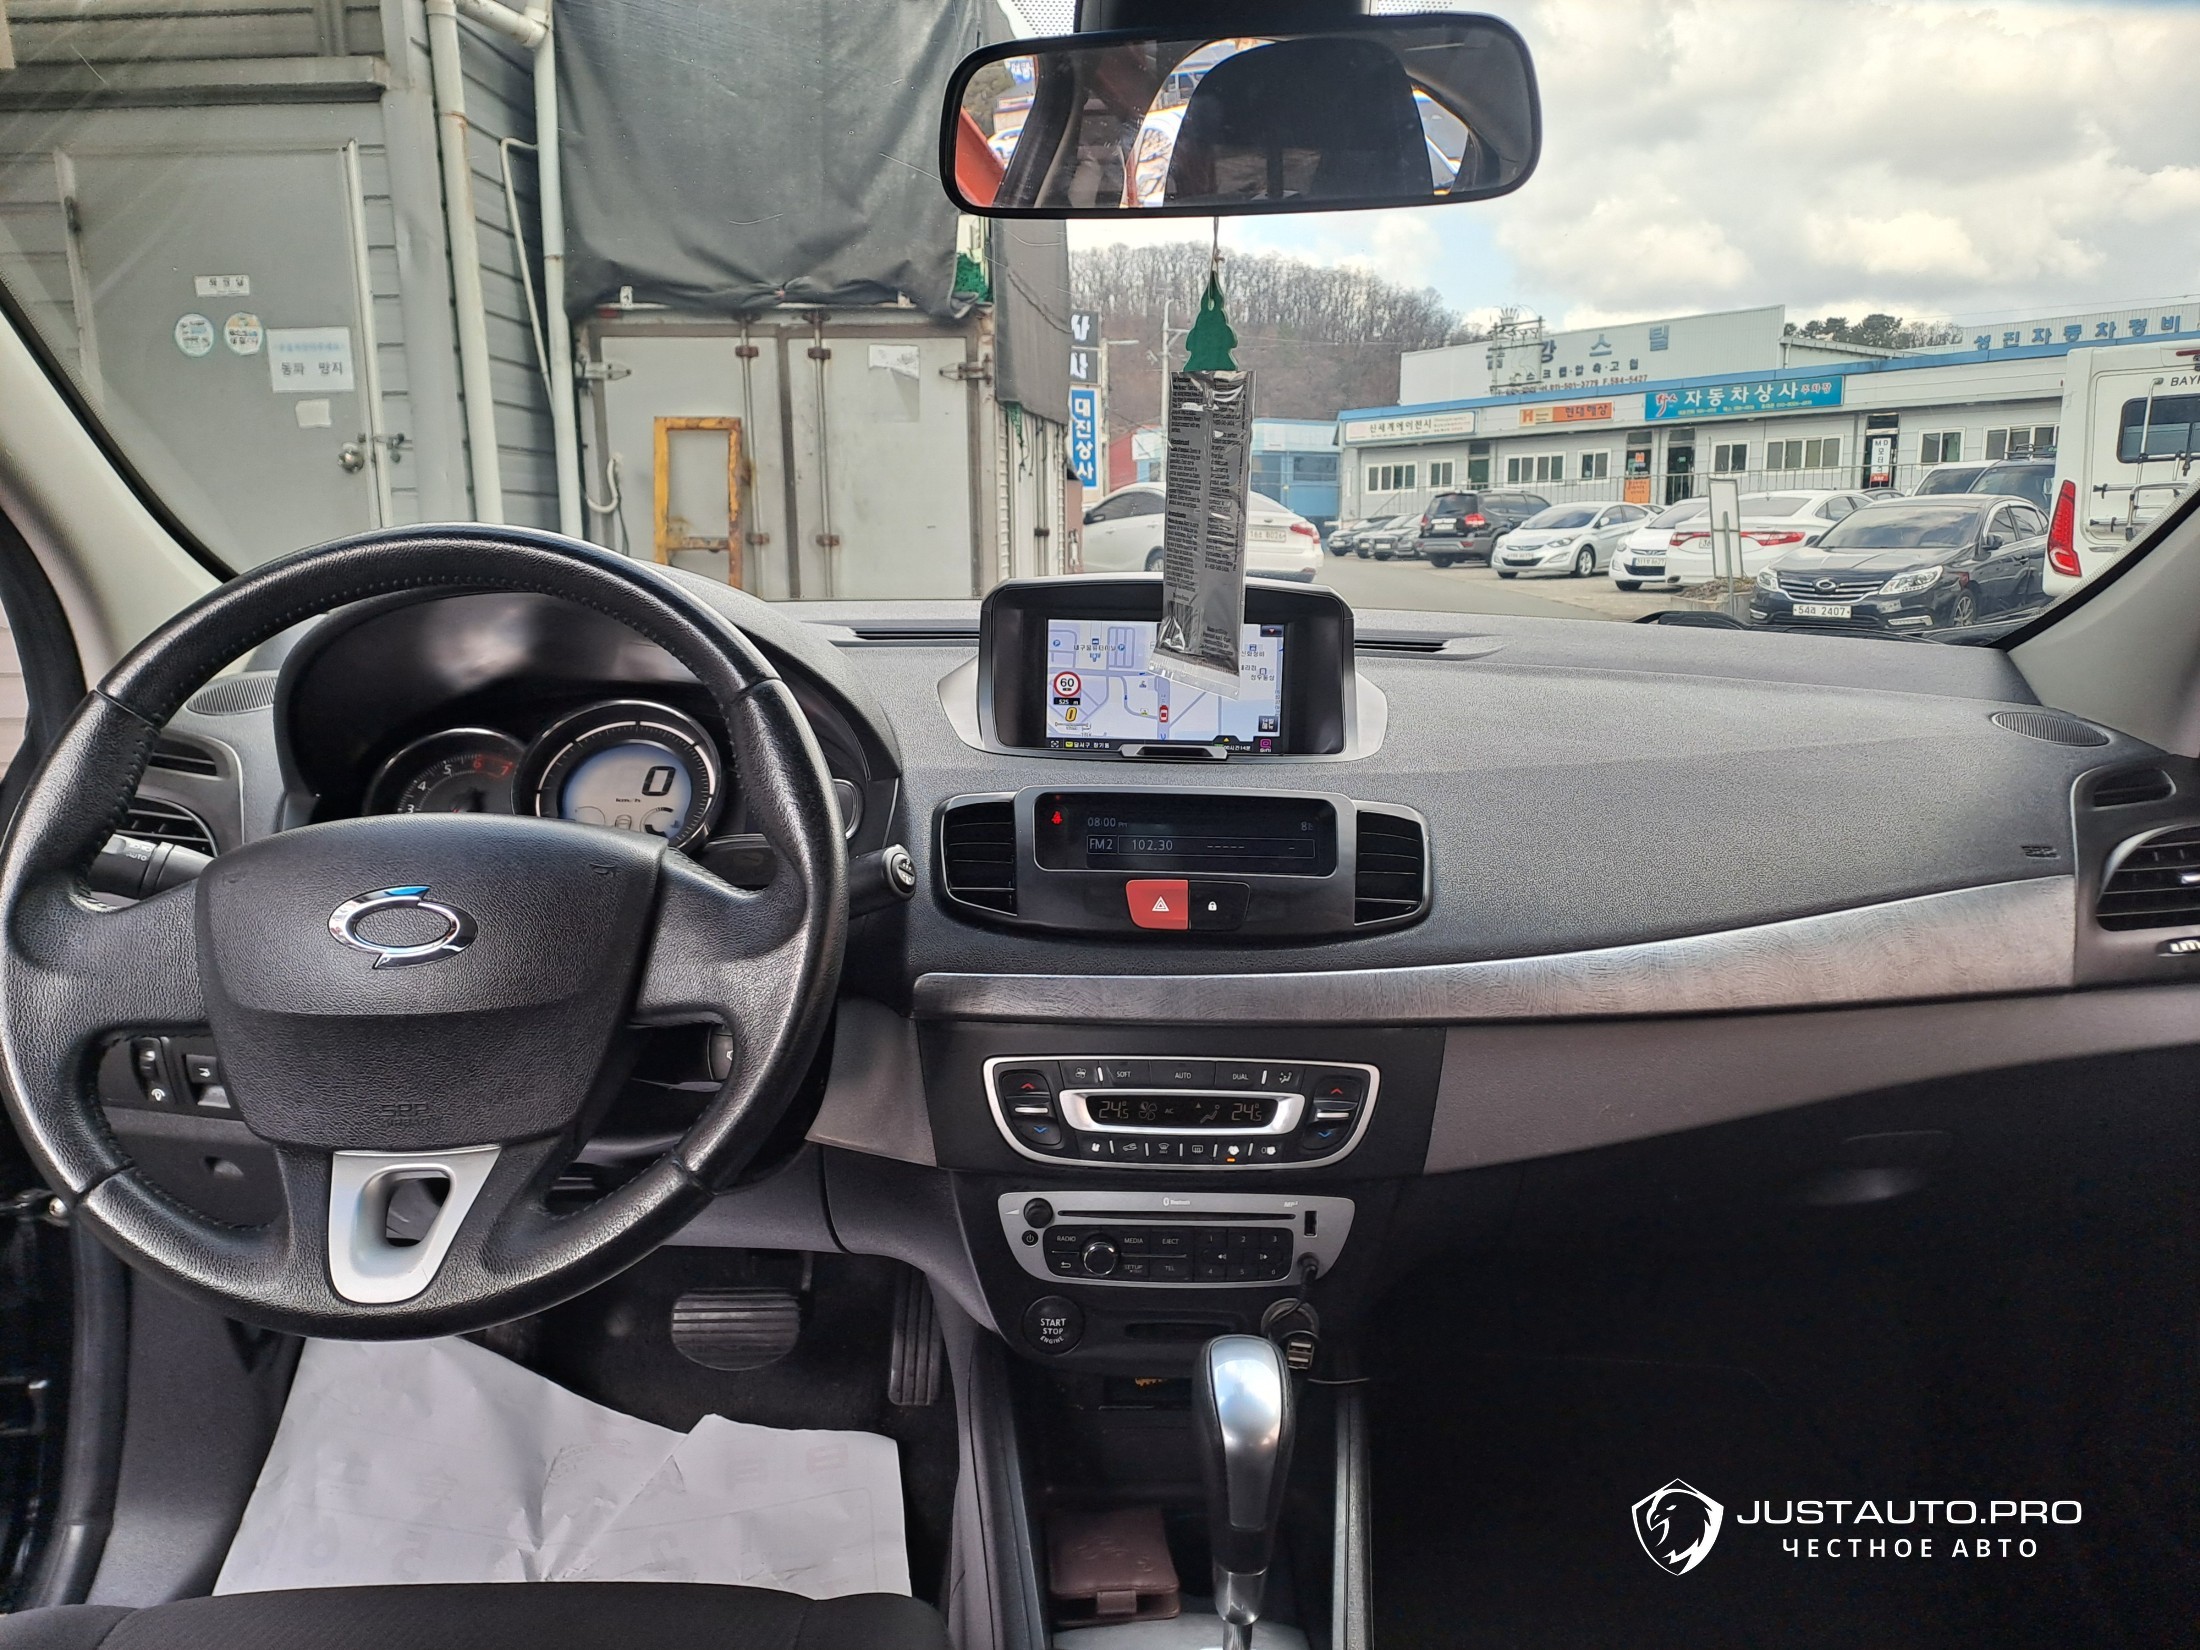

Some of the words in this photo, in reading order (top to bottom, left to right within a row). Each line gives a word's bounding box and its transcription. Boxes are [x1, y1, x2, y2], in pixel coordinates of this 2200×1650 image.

[1974, 315, 2180, 350] 성진자동차정비
[1684, 381, 1798, 407] 자동차상사
[1821, 606, 1846, 616] 2407
[1060, 678, 1075, 688] 60
[1073, 741, 1091, 749] 달서구
[472, 758, 482, 770] 6
[443, 764, 451, 775] 5
[500, 764, 510, 776] 7
[417, 780, 427, 791] 4
[641, 765, 676, 796] 0
[1087, 817, 1116, 828] 08:00
[1132, 839, 1173, 851] 102.30
[1116, 1070, 1132, 1078] SOFT
[1174, 1072, 1192, 1080] AUTO
[1232, 1073, 1249, 1081] DUAL
[1056, 1235, 1077, 1243] RADIO
[1161, 1238, 1180, 1246] EJECT
[1040, 1318, 1067, 1327] START
[1040, 1335, 1065, 1344] ENGINE
